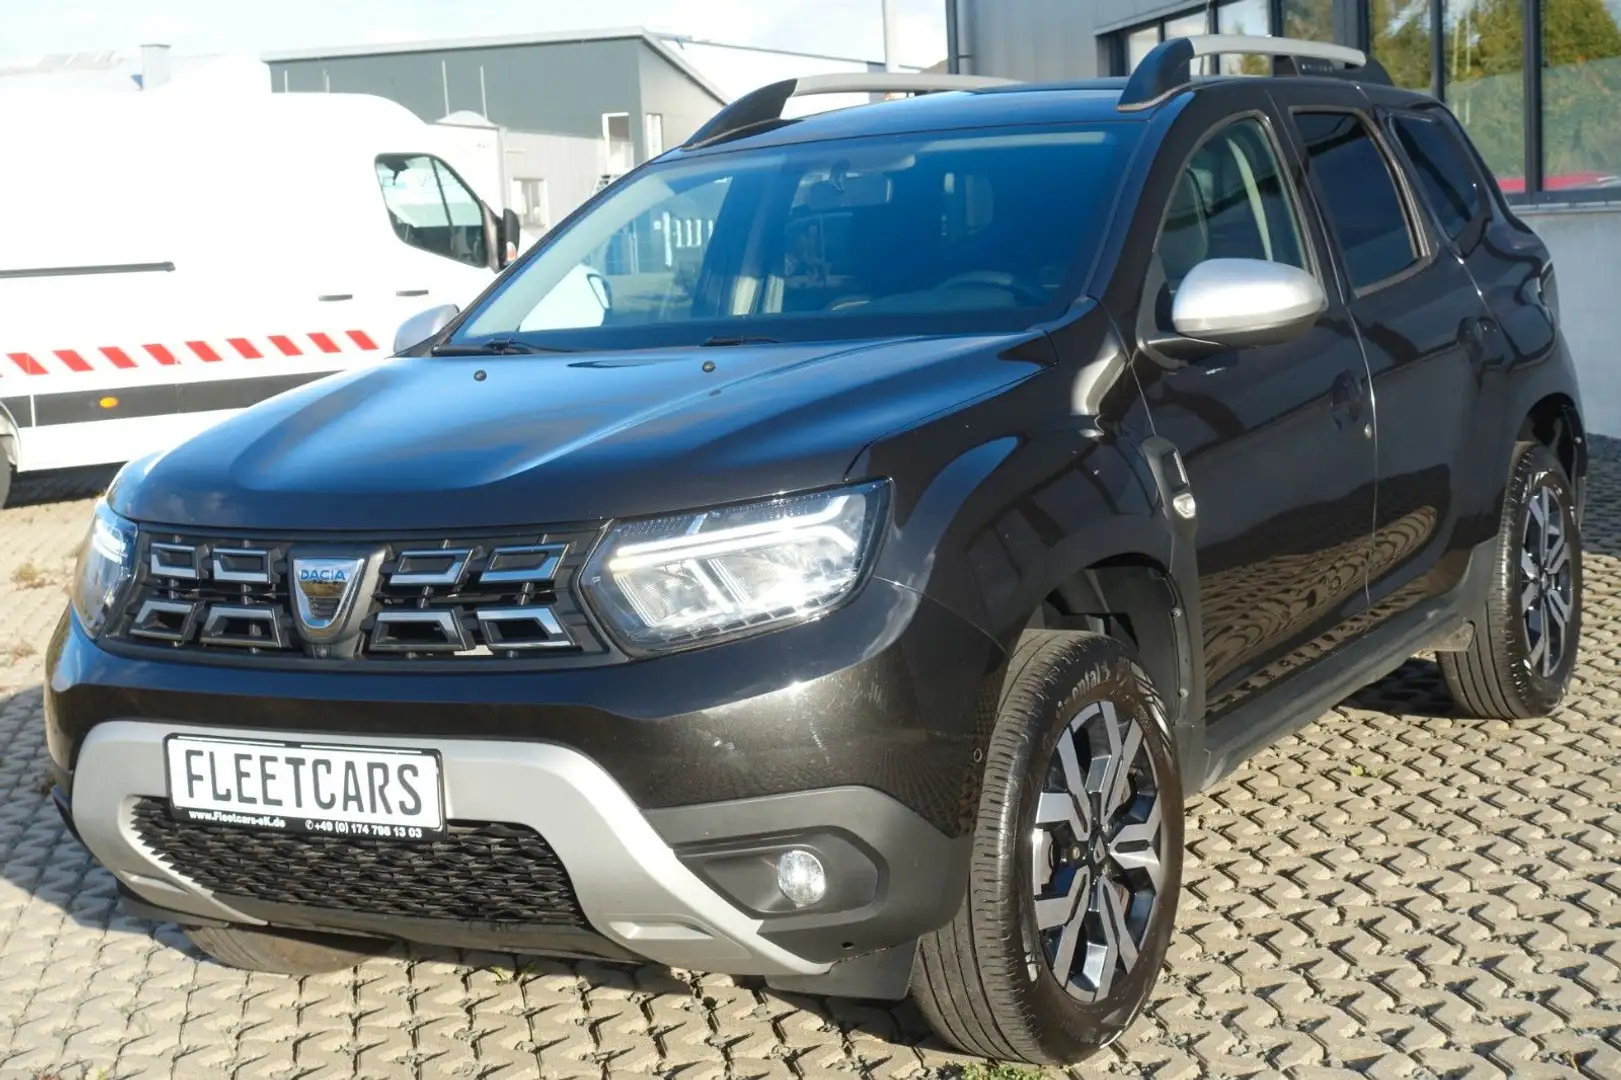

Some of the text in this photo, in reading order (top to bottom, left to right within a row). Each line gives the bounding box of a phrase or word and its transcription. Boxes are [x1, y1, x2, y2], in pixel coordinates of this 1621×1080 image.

[300, 569, 346, 581] DACIA
[185, 749, 422, 816] FLEETCARS
[335, 821, 349, 834] (0)
[351, 823, 370, 835] 174
[393, 826, 406, 837] 13
[408, 827, 423, 838] 03
